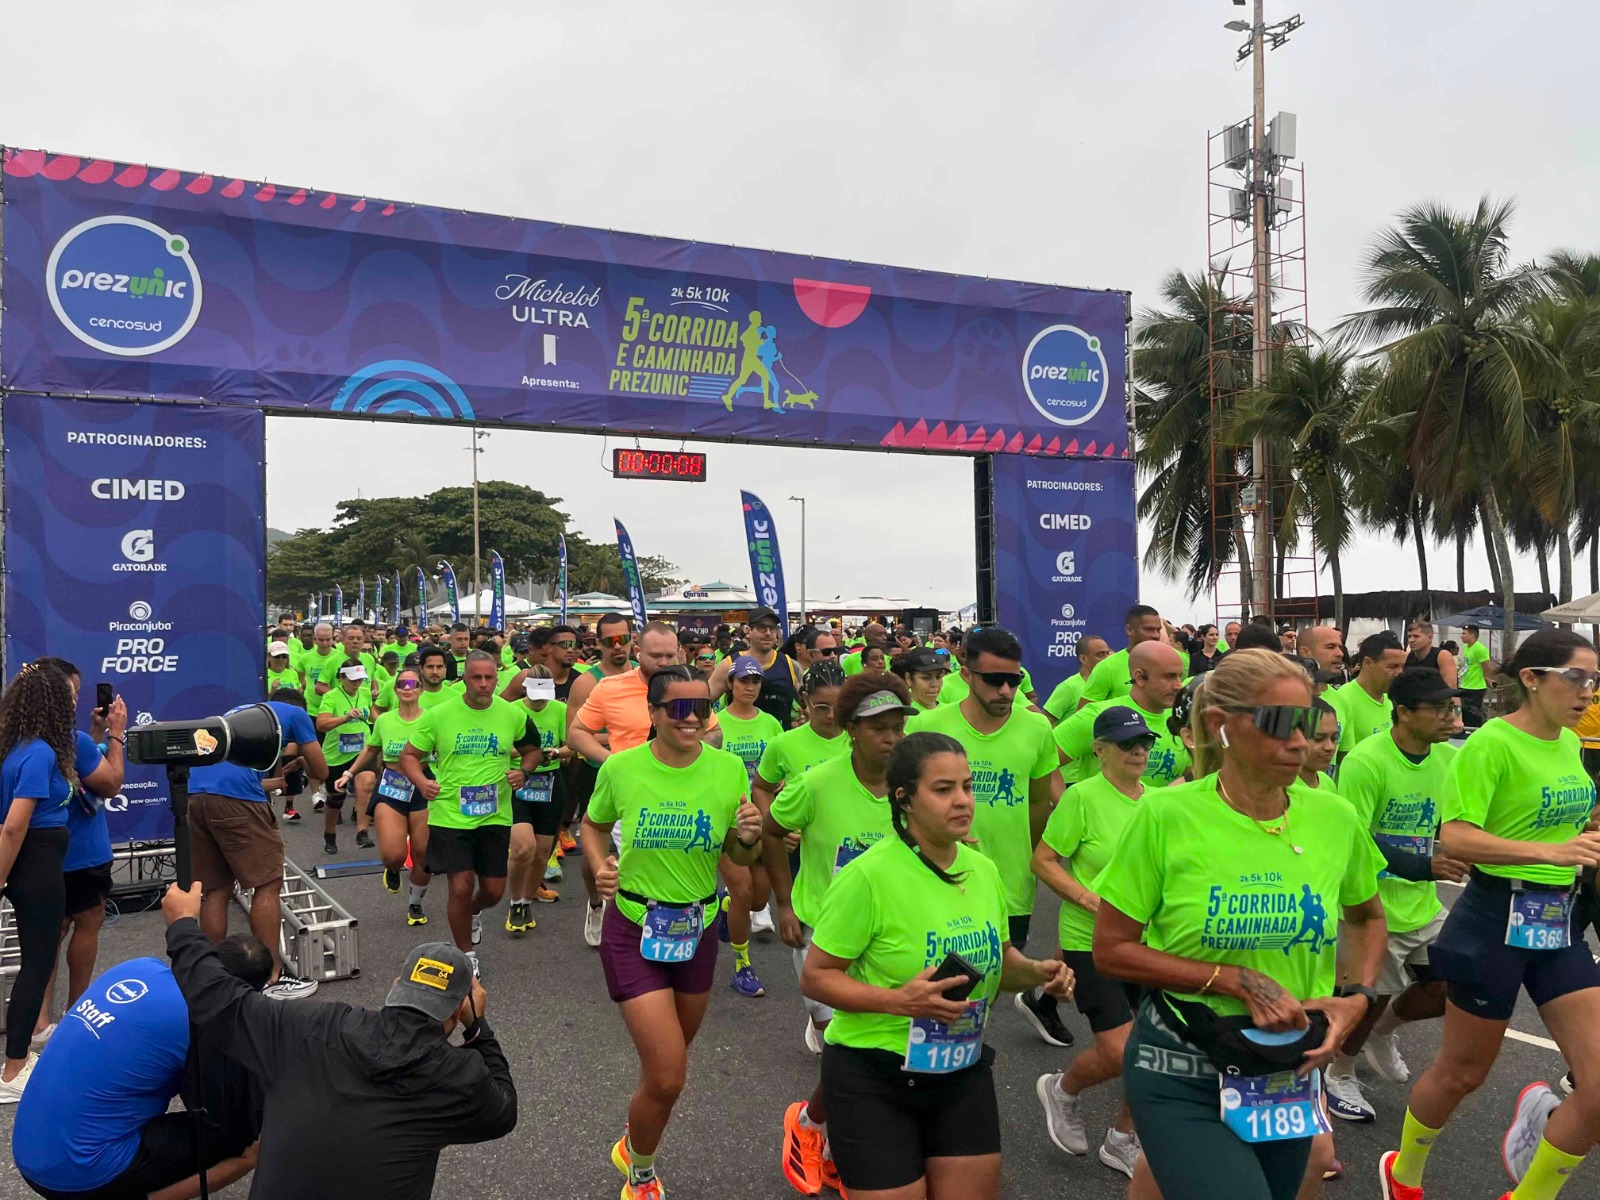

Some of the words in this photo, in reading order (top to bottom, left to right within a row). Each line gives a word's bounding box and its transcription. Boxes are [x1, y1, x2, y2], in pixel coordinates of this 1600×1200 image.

[61, 268, 187, 299] prezunic
[495, 274, 602, 307] Michelob
[671, 287, 684, 298] 2k
[686, 287, 702, 300] 5k
[705, 287, 730, 302] 10k
[89, 316, 162, 332] cencosud
[512, 305, 591, 328] ULTRA
[649, 314, 739, 349] CORRIDA
[616, 345, 629, 366] E
[633, 346, 736, 376] CAMINHADA
[1031, 361, 1100, 384] prezunic
[522, 375, 580, 389] Apresenta:
[609, 369, 690, 397] PREZUNIC
[1047, 398, 1087, 408] cencosud
[67, 432, 207, 449] PATROCINADORES:
[618, 451, 703, 476] 00:00:08
[91, 478, 186, 501] CIMED
[1027, 480, 1104, 492] PATROCINADORES:
[1039, 514, 1092, 530] CIMED
[112, 563, 168, 572] GATORADE
[1051, 575, 1083, 583] GATORADE
[683, 590, 709, 599] Corona
[110, 621, 171, 634] Piracanjuba
[1051, 618, 1085, 627] Piracanjuba
[117, 637, 164, 655] PRO
[1047, 645, 1078, 657] FOR
[101, 656, 179, 674] FORCE
[385, 786, 406, 799] 1728
[523, 791, 546, 800] 1408
[1556, 787, 1590, 806] CORRIDA
[468, 803, 492, 815] 1463
[649, 812, 693, 827] CORRIDA
[635, 828, 641, 838] E
[641, 827, 692, 840] CAMINHADA
[632, 838, 669, 850] PREZUNIC
[1250, 874, 1262, 882] 5k
[1264, 872, 1283, 882] 10k
[1228, 893, 1298, 915] CORRIDA
[1204, 920, 1213, 935] E
[1216, 916, 1297, 935] CAMINHADA
[943, 929, 988, 955] CORRIDA
[1201, 935, 1261, 951] PREZUNIC
[1525, 928, 1563, 948] 1369
[652, 941, 693, 960] 1748
[438, 971, 448, 979] 64
[76, 999, 116, 1029] Staff
[927, 1042, 977, 1069] 1197
[1337, 1100, 1362, 1114] FILA
[1246, 1105, 1306, 1138] 1189
